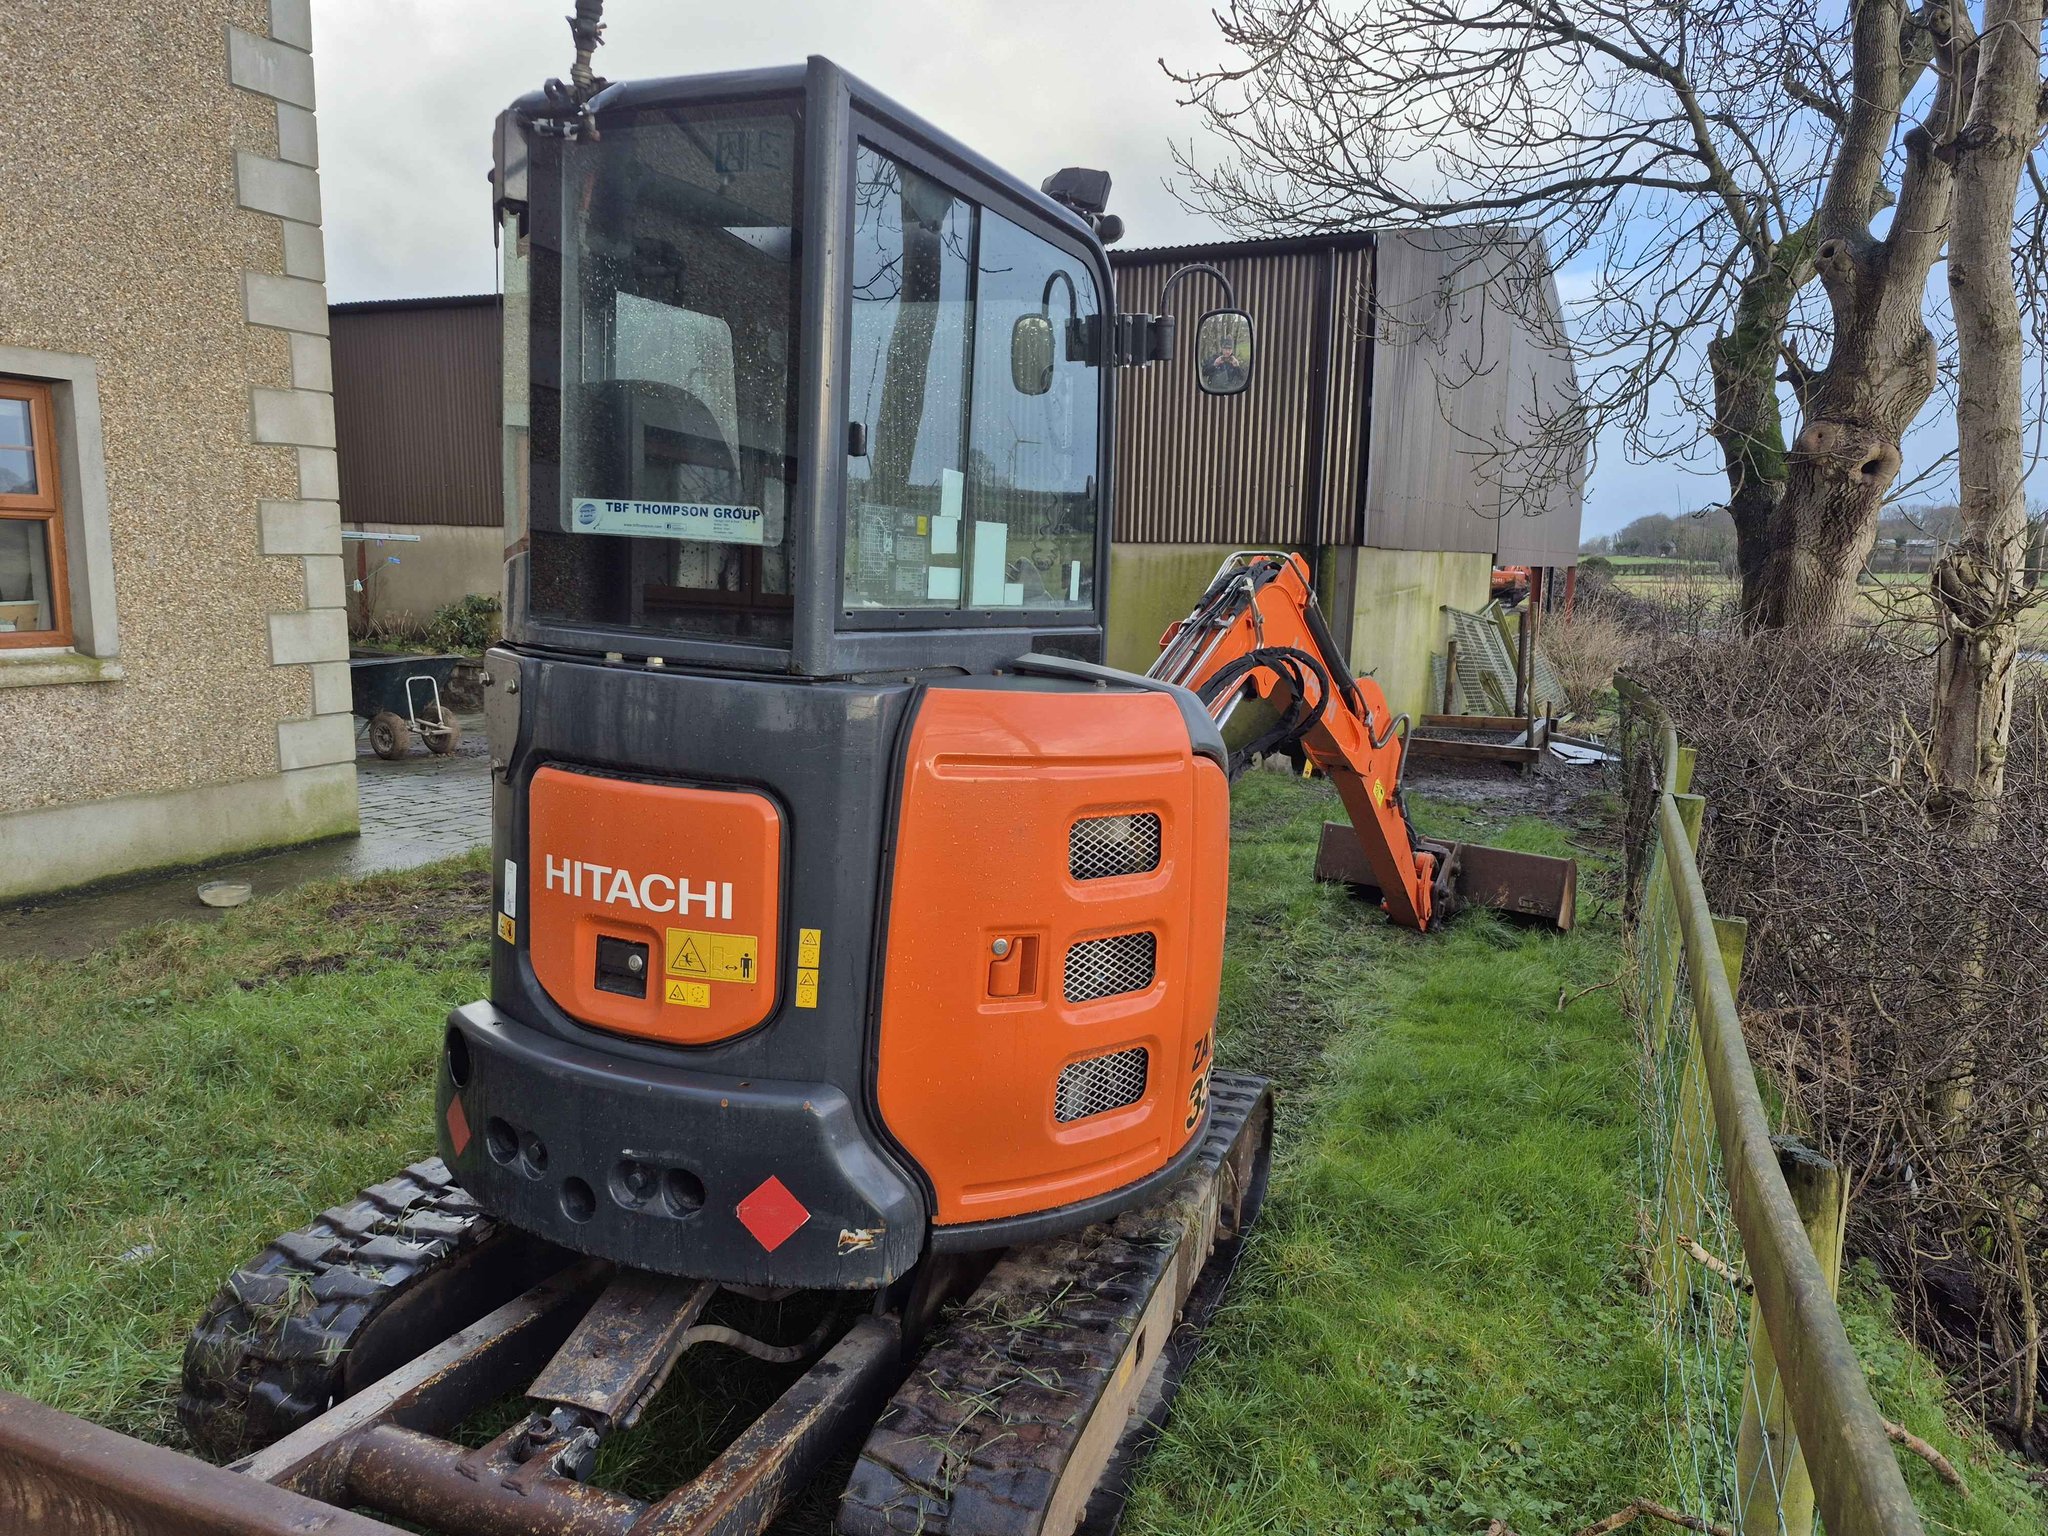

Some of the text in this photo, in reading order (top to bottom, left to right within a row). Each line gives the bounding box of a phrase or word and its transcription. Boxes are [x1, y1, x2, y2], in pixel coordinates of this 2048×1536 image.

[605, 502, 629, 513] TBF
[634, 503, 709, 518] THOMPSON
[713, 507, 761, 521] GROUP
[546, 853, 733, 920] HITACHI
